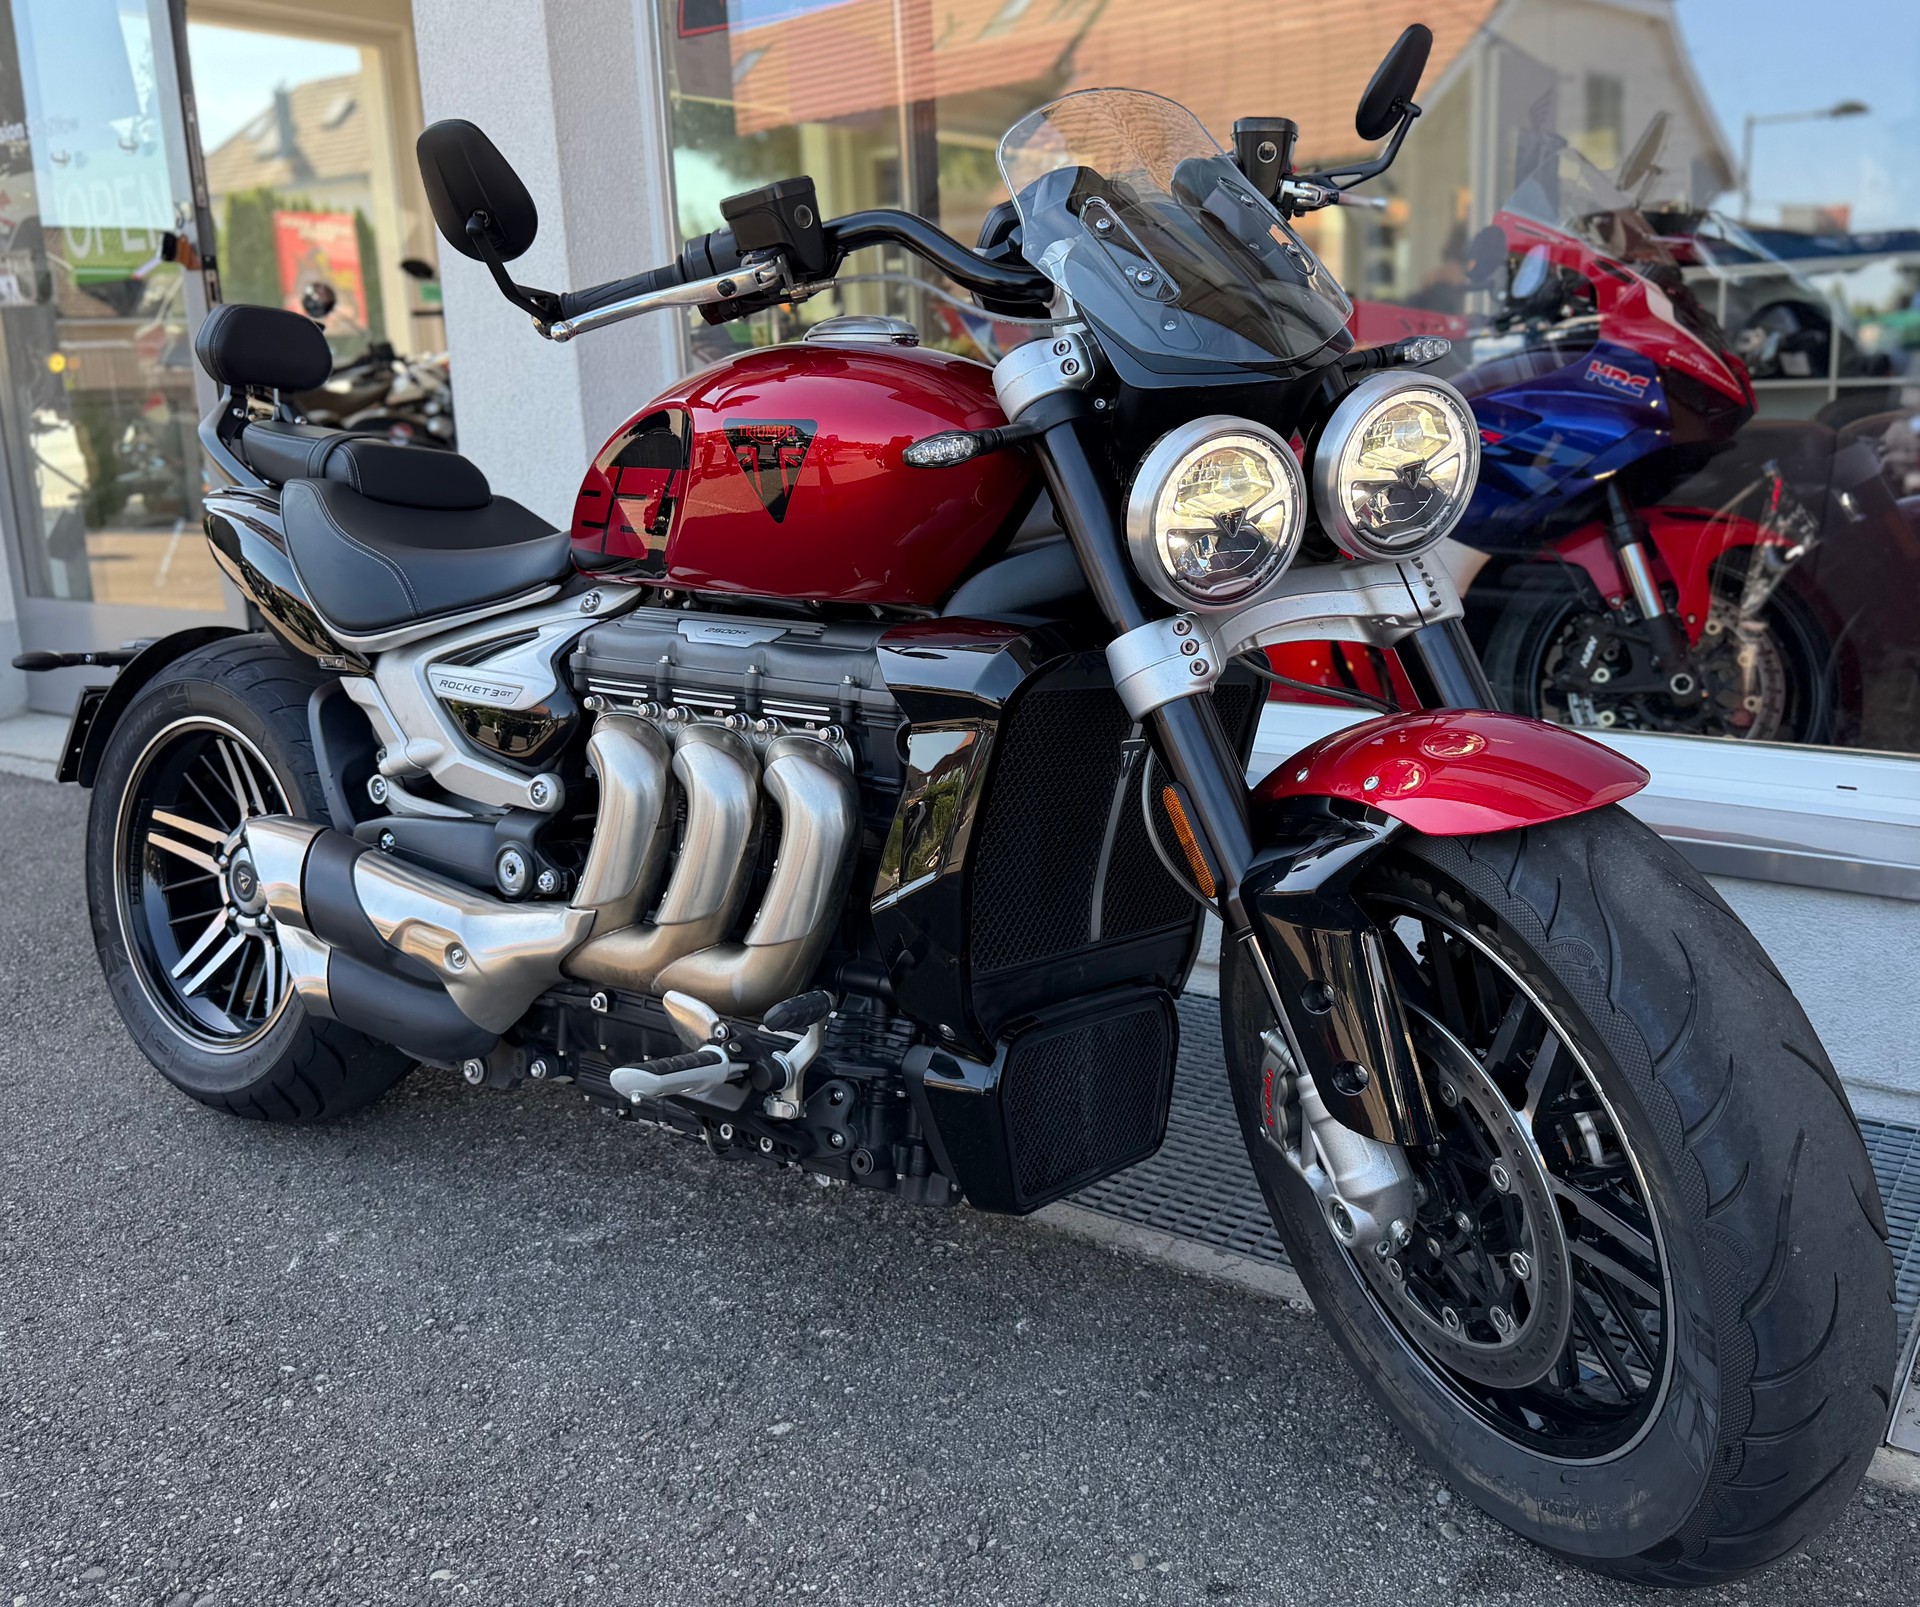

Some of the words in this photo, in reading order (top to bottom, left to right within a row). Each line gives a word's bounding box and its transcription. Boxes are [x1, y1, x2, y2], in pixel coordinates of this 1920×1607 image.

[60, 171, 168, 259] OPEN
[1584, 359, 1650, 398] HRC
[738, 424, 797, 438] TRIUMPH
